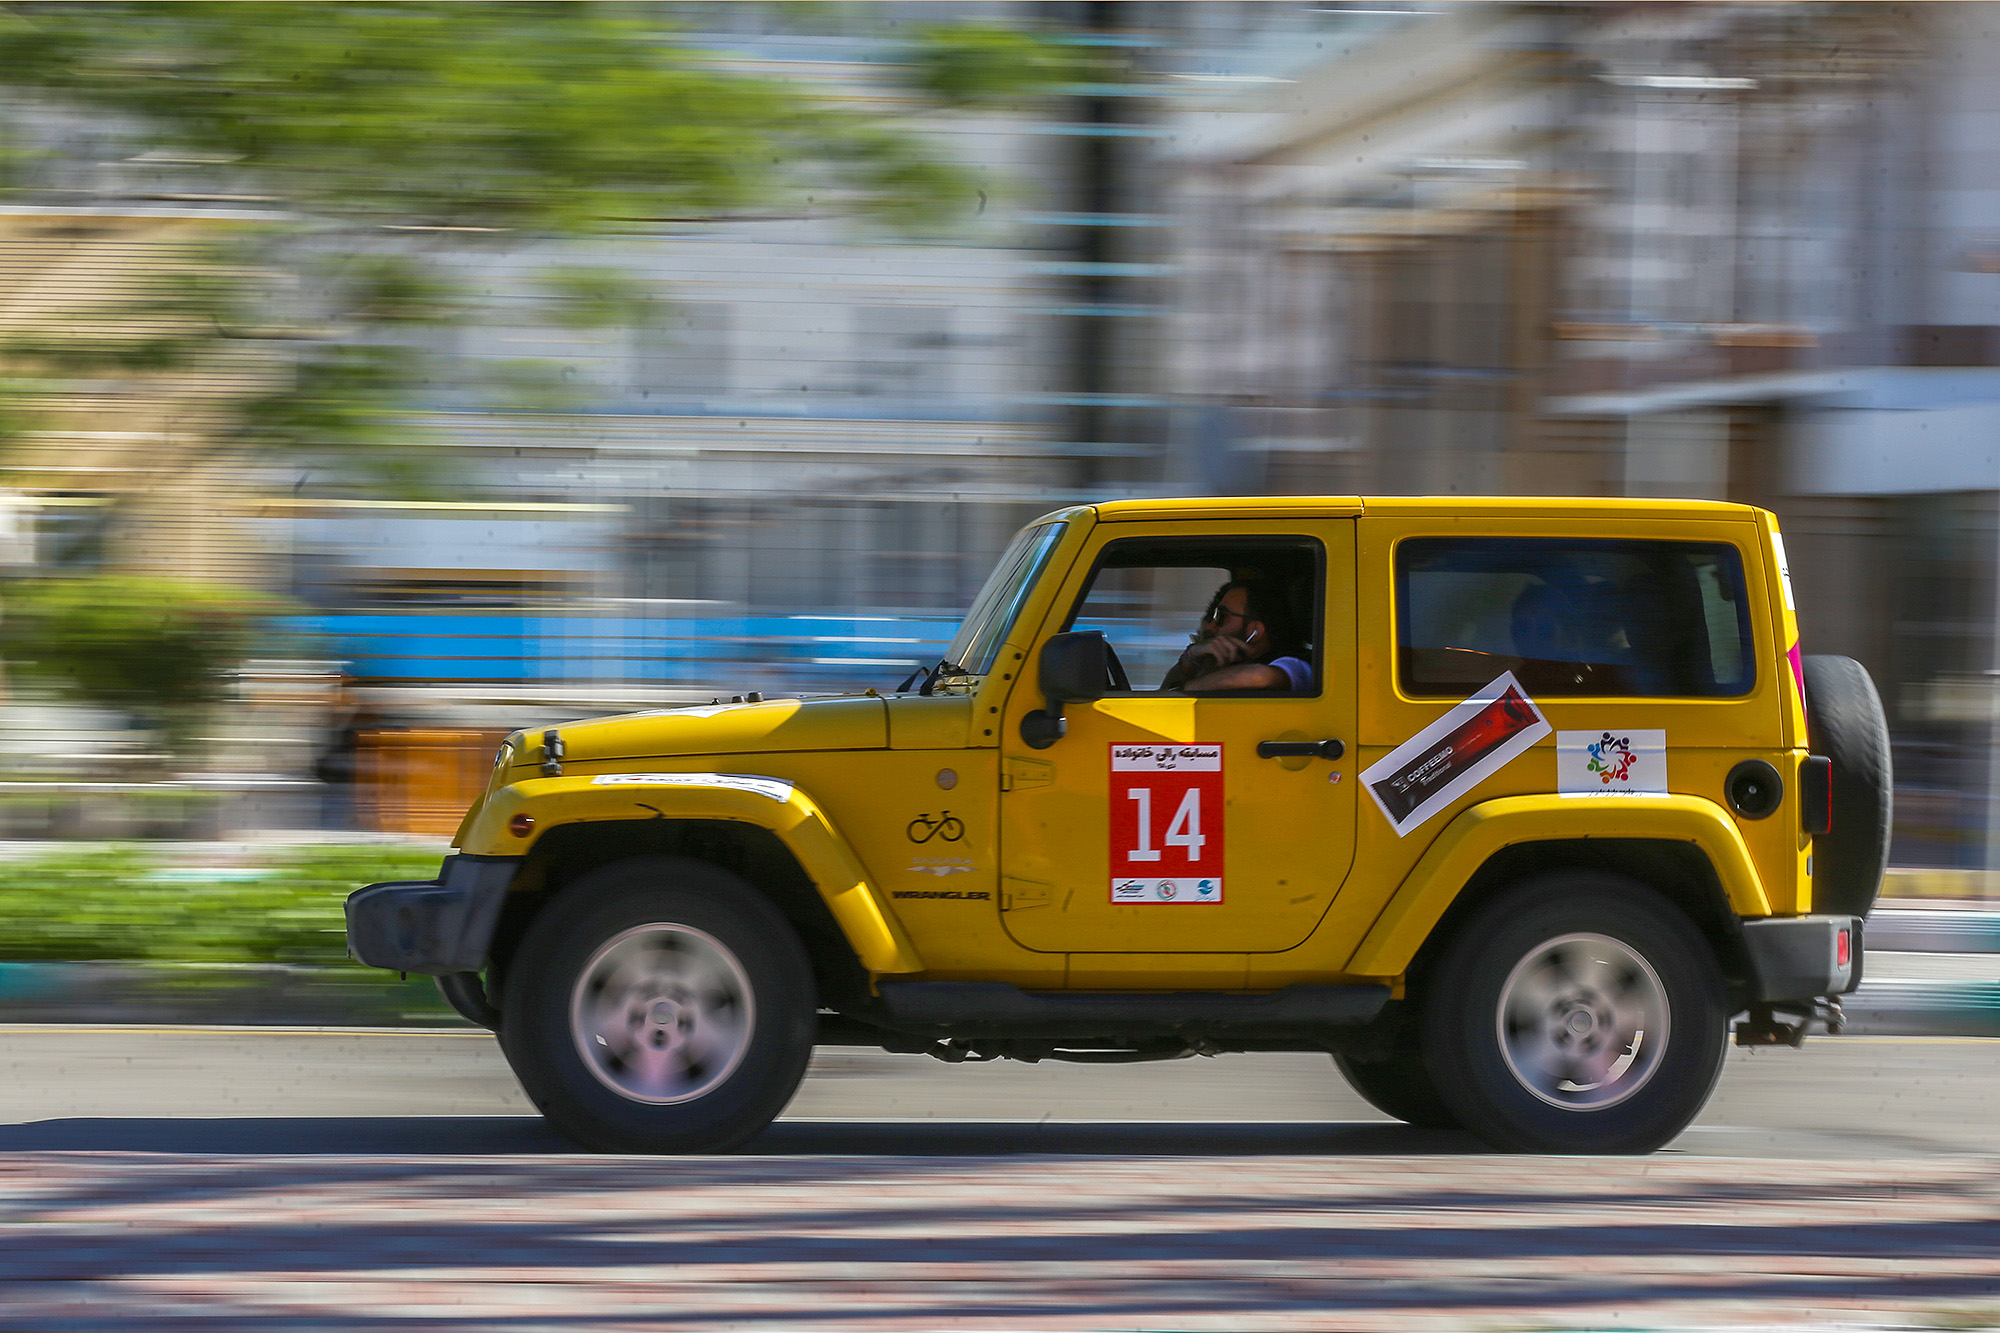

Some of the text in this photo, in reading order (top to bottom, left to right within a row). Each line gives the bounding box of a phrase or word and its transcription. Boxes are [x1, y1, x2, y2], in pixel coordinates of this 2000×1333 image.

[1114, 747, 1154, 761] خانواده
[1178, 747, 1219, 761] مسابقه
[1407, 746, 1453, 782] COFFEEMO
[1127, 787, 1206, 862] 14
[892, 891, 991, 900] WRANGLER
